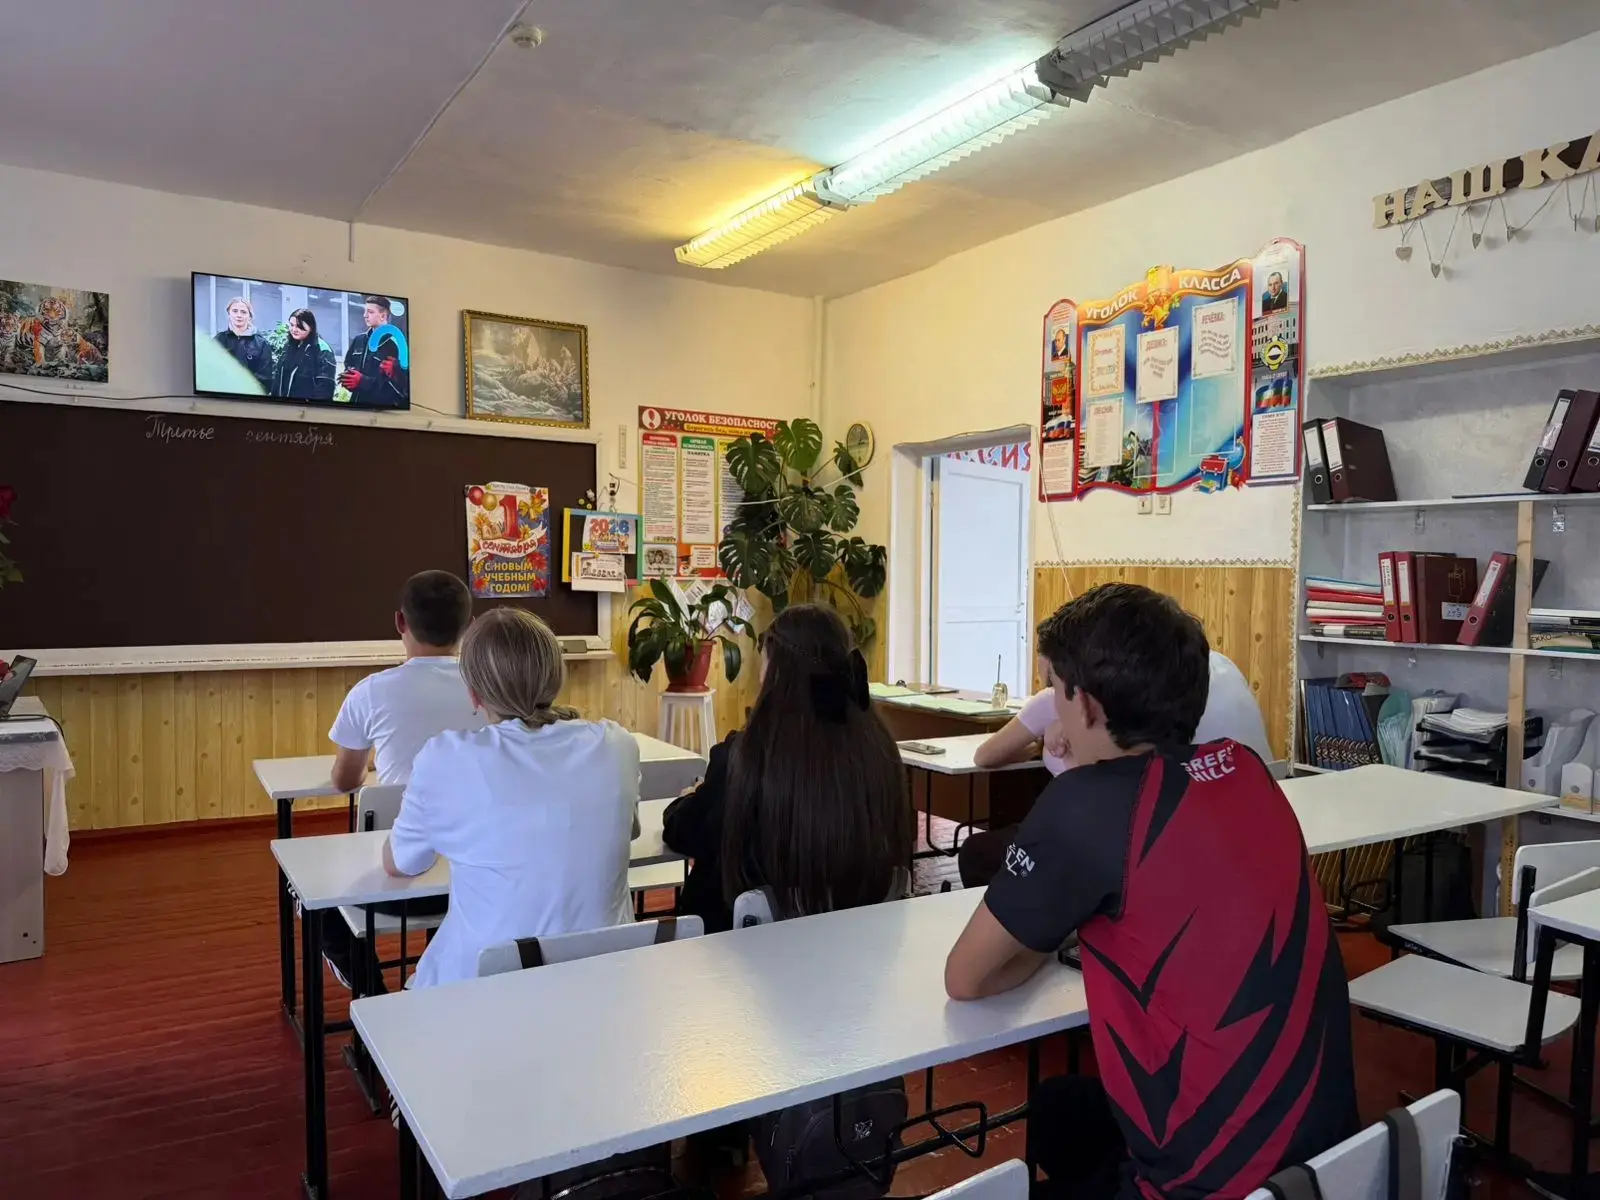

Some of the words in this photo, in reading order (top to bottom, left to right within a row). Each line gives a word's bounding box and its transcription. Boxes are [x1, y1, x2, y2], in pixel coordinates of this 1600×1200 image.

[1086, 290, 1137, 319] УГОЛОК
[1178, 268, 1241, 290] КЛАССА
[664, 411, 707, 424] УГОЛОК
[708, 415, 781, 430] БЕЗОПАСНОСТ
[499, 495, 521, 539] 1
[591, 518, 630, 535] 2026
[485, 562, 491, 571] С
[494, 562, 533, 571] НОВЫМ
[484, 572, 536, 581] УЧЕБНЫМ
[490, 583, 530, 593] ГОДОМ!
